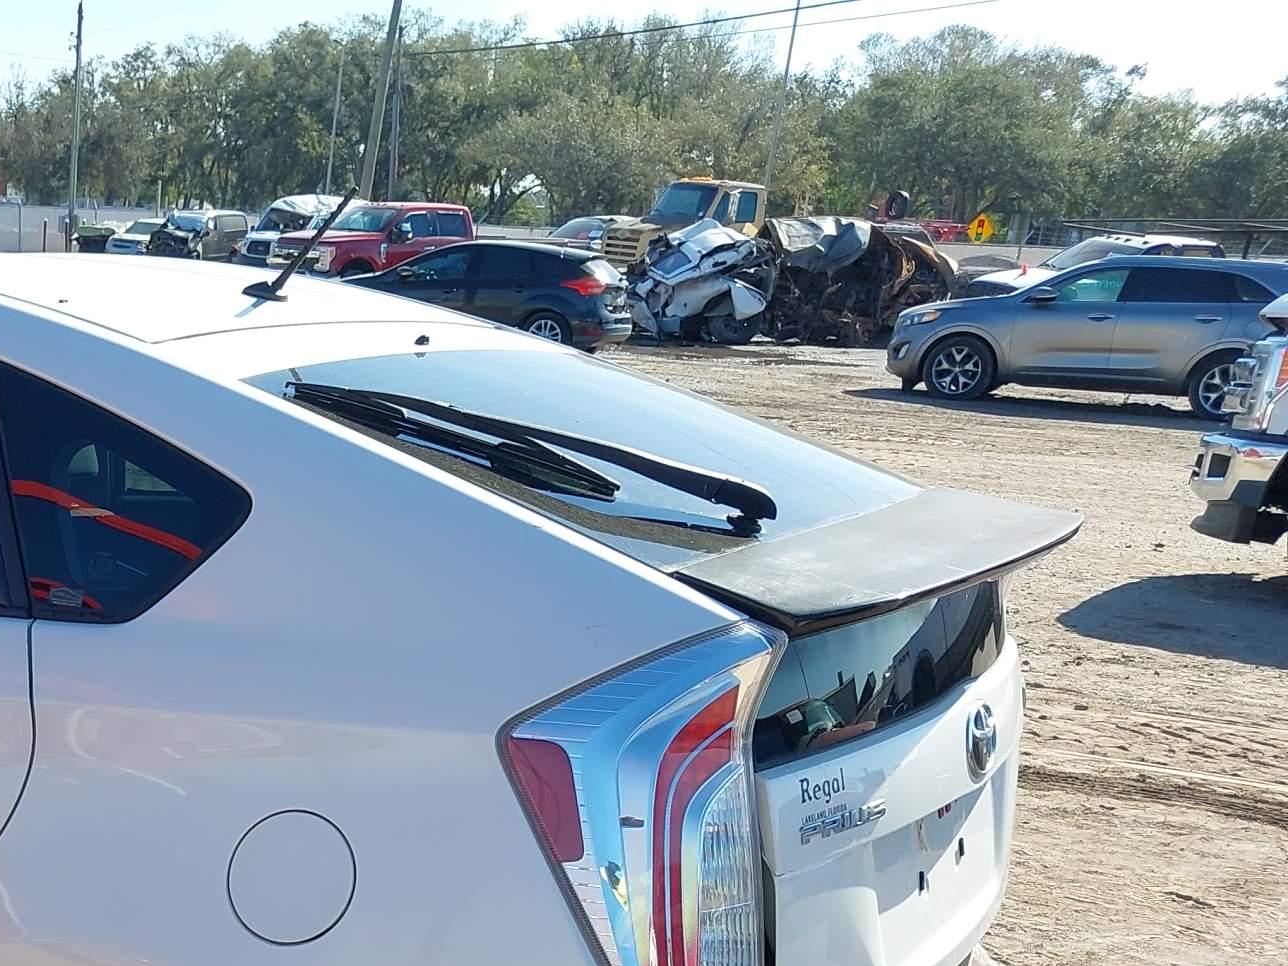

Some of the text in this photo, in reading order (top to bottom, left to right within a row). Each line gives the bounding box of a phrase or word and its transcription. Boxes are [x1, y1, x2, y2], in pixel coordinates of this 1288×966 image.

[798, 767, 846, 805] Regal
[799, 799, 887, 846] PRIUS
[827, 802, 848, 817] FLORIDA
